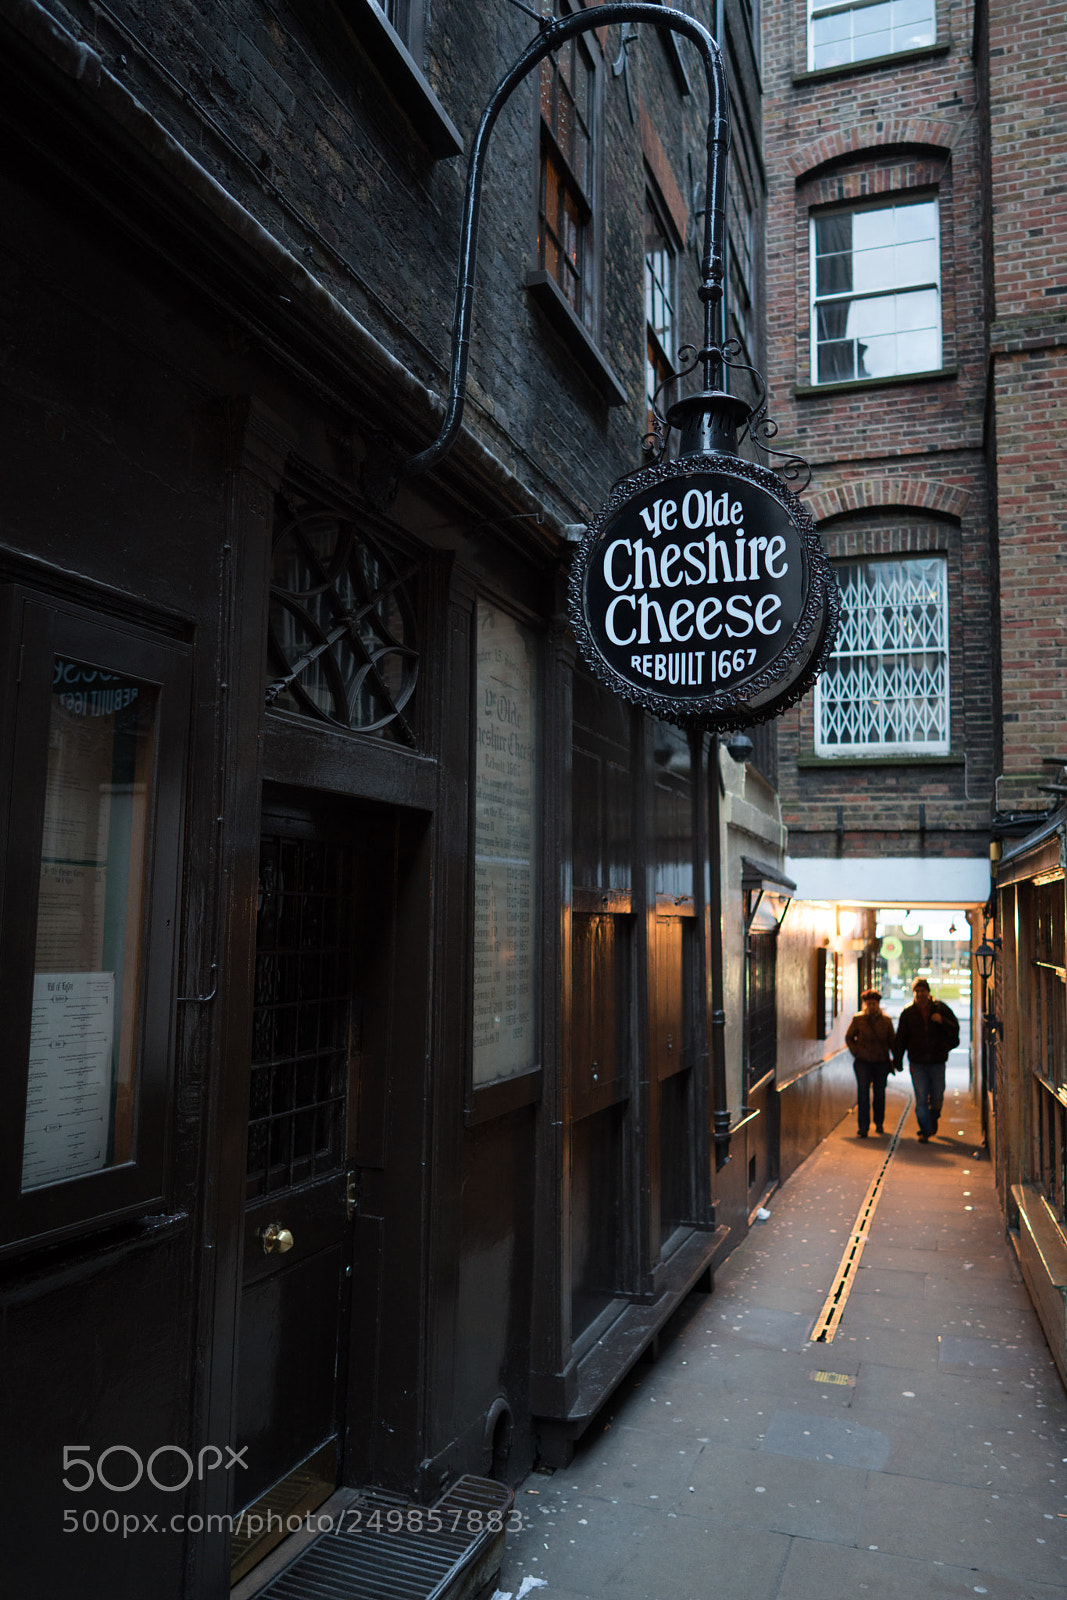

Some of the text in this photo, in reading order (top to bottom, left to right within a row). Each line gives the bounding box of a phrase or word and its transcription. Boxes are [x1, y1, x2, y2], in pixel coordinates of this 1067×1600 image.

[682, 488, 744, 530] Olde
[603, 528, 789, 592] Cheshire
[604, 592, 783, 646] Cheese
[630, 648, 757, 686] REBUILT 1667
